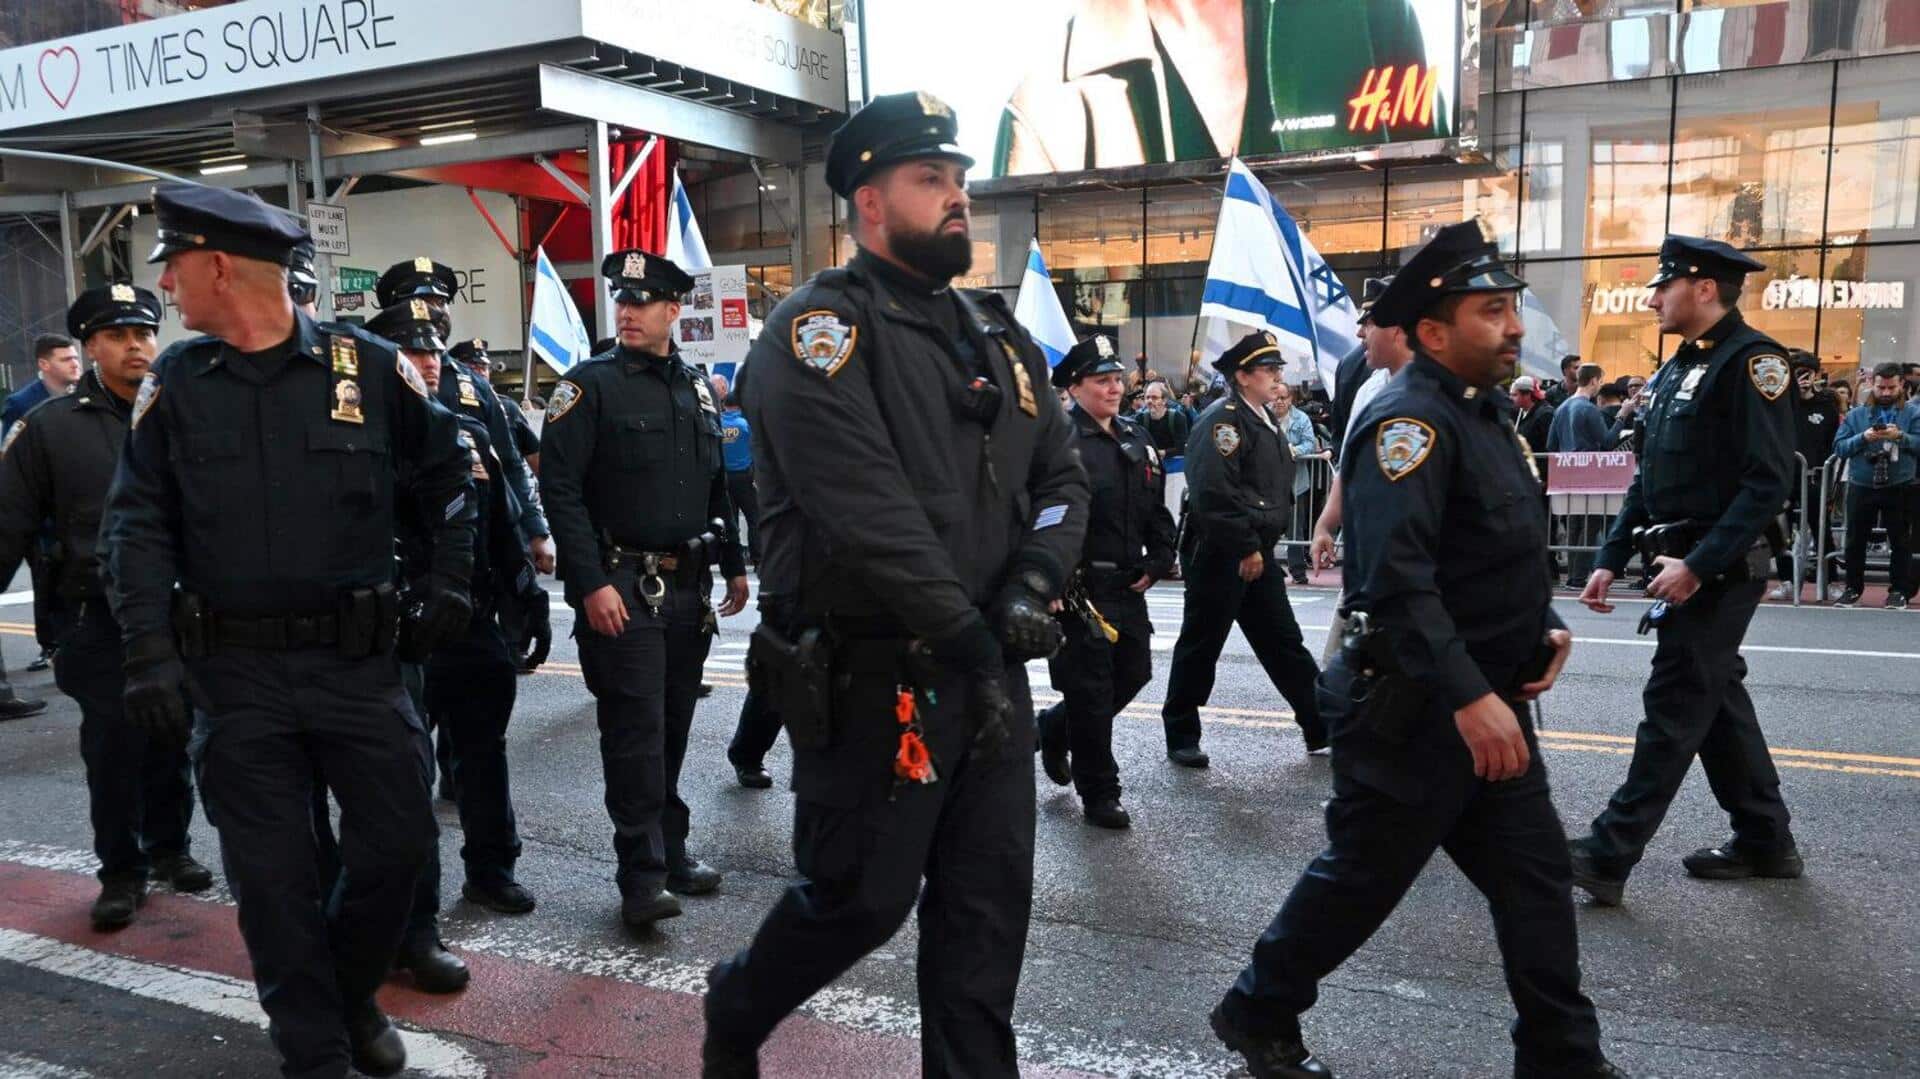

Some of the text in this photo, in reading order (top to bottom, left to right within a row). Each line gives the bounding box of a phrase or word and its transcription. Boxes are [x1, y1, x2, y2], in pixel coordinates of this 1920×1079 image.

[95, 28, 209, 95] TIMES
[223, 0, 397, 74] SQUARE
[764, 35, 830, 81] SQUARE
[1348, 63, 1439, 132] H&M
[311, 209, 345, 221] LEFT LANE
[318, 224, 339, 235] MUST
[332, 241, 347, 250] LEFT
[1555, 452, 1626, 468] בארץ ישראל
